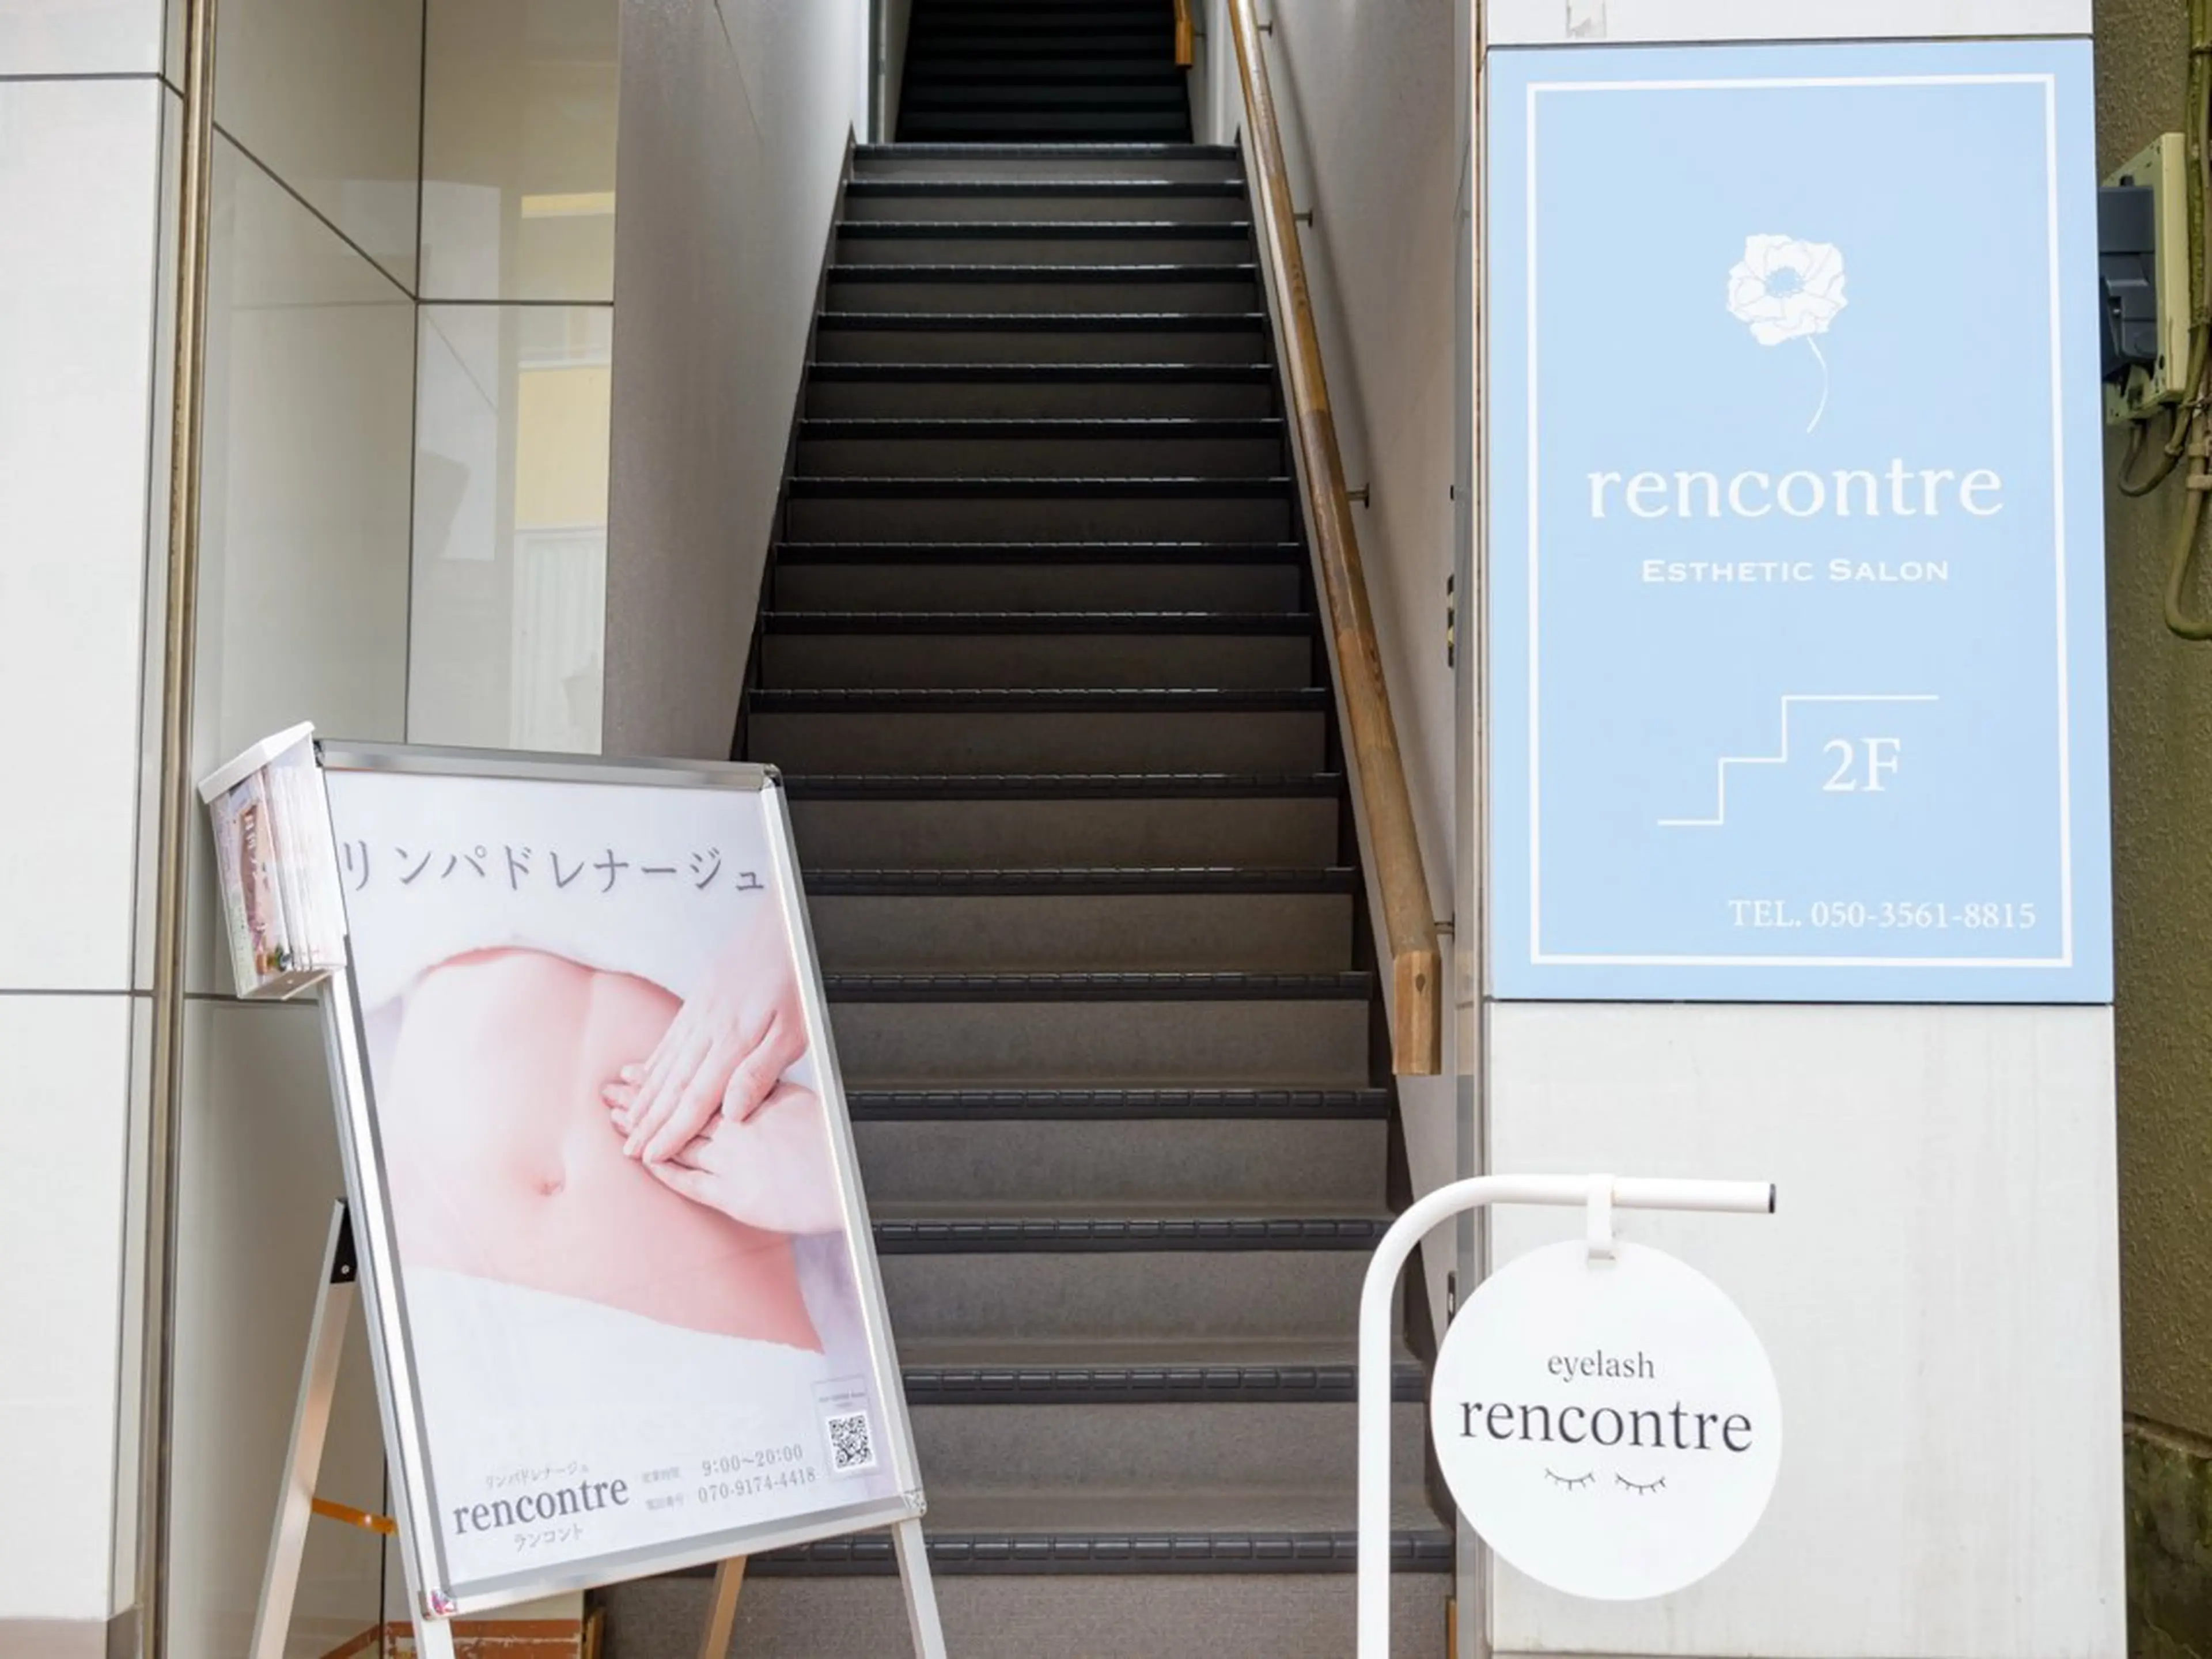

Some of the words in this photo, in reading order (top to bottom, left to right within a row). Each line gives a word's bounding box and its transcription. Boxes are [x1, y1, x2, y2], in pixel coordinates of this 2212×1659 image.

[1588, 457, 2004, 518] rencontre
[1821, 738, 1901, 791] 2F
[344, 840, 764, 893] リンパドレナージュ
[1729, 900, 1801, 928] TEL.
[1810, 900, 2036, 929] 050-3561-8815
[1547, 1350, 1656, 1383] eyelash
[1460, 1400, 1753, 1452] rencontre
[453, 1479, 630, 1535] rencontre
[514, 1522, 584, 1552] ランコント
